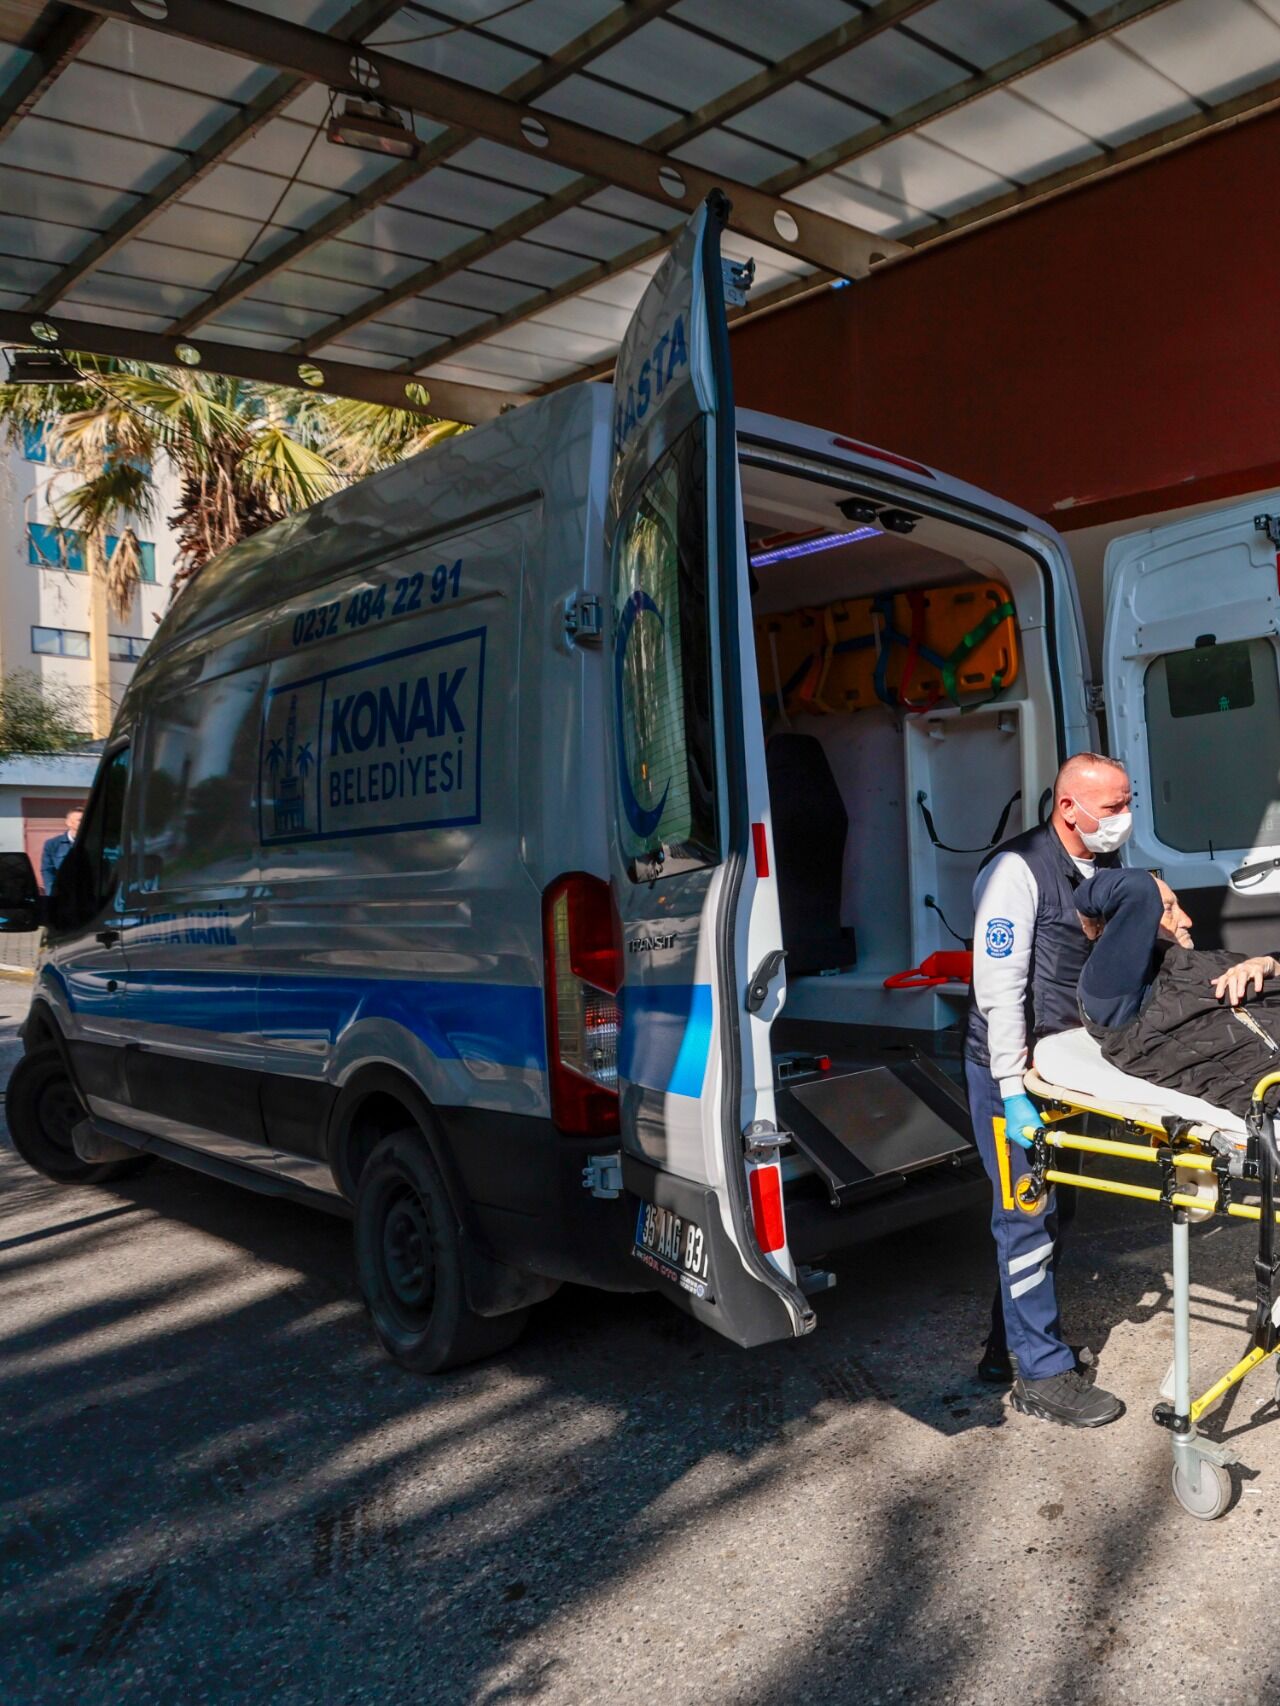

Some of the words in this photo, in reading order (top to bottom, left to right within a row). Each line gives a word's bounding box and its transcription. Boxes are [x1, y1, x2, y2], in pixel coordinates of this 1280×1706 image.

[292, 601, 341, 646] 0232
[345, 583, 387, 628] 484
[392, 571, 424, 616] 22
[430, 558, 463, 604] 91
[330, 667, 467, 757] KONAK
[329, 736, 463, 808] BELEDİYESİ
[629, 932, 677, 952] TRANSIT
[642, 1204, 656, 1247] 35
[658, 1212, 681, 1262] AAG
